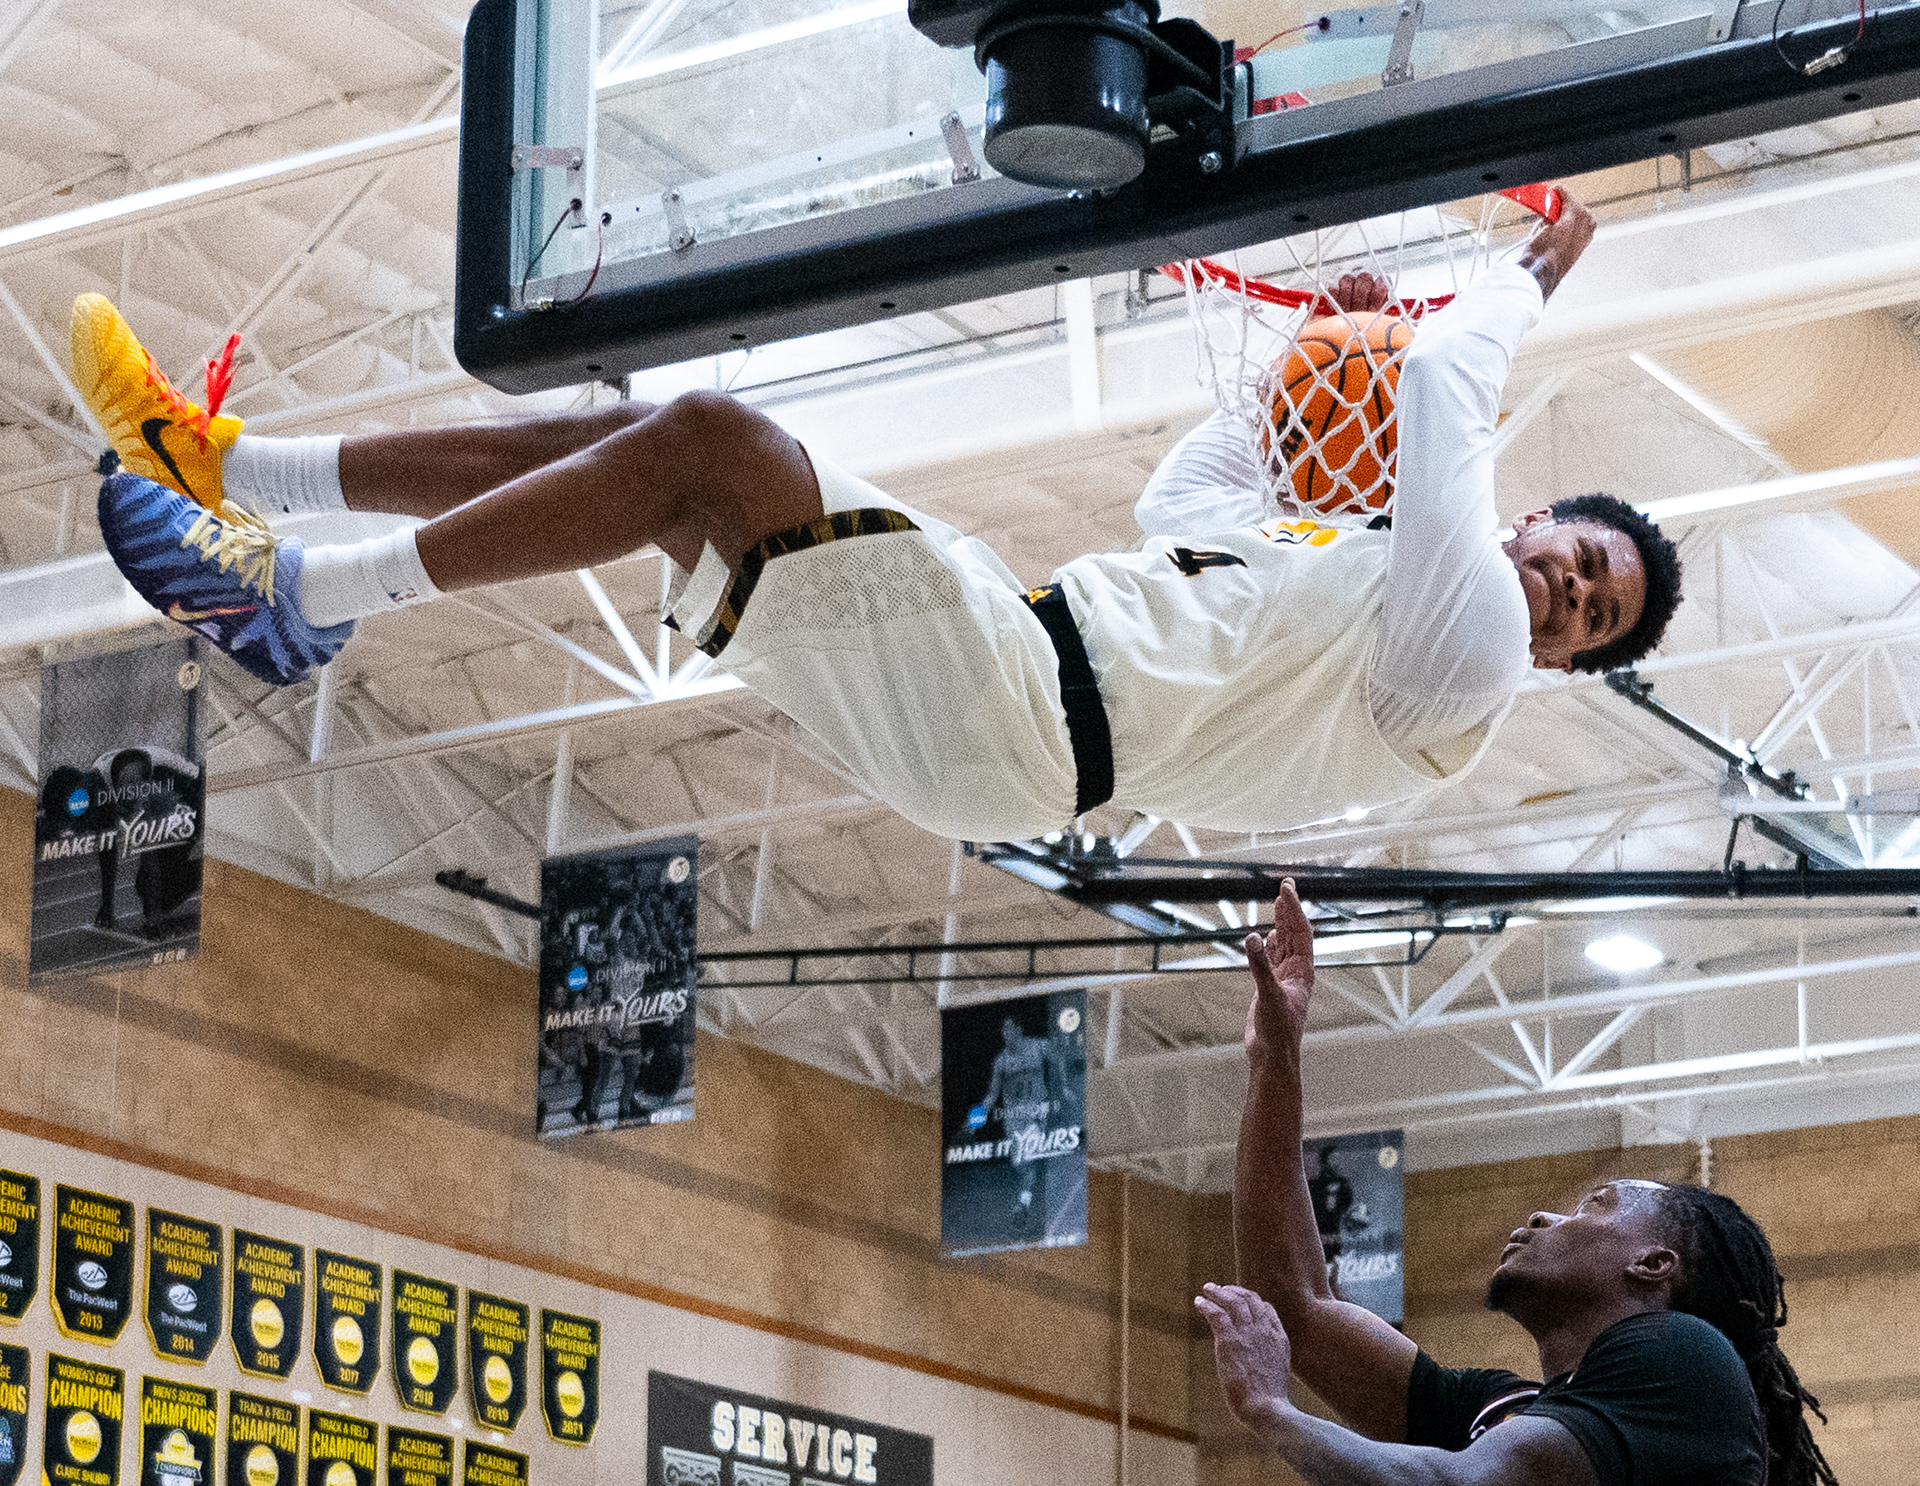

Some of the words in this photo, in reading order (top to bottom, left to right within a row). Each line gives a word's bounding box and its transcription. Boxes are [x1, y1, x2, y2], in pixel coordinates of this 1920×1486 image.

[97, 781, 162, 806] DIVISION
[41, 834, 95, 861] MAKE
[99, 830, 118, 852] IT
[119, 808, 197, 859] YOURS
[545, 1008, 595, 1032] MAKE
[598, 1004, 616, 1023] IT
[617, 986, 689, 1031] YOURS
[947, 1141, 993, 1164] MAKE
[996, 1138, 1013, 1157] IT
[1013, 1123, 1081, 1165] YOURS
[69, 1198, 121, 1224] ACADEMIC
[60, 1212, 130, 1243] ACHIEVEMENT
[160, 1221, 210, 1248] ACADEMIC
[75, 1234, 113, 1257] AWARD
[153, 1237, 219, 1266] ACHIEVEMENT
[245, 1242, 294, 1267] ACADEMIC
[166, 1258, 202, 1280] AWARD
[237, 1256, 302, 1285] ACHIEVEMENT
[326, 1260, 373, 1286] ACADEMIC
[251, 1277, 286, 1299] AWARD
[321, 1274, 381, 1303] ACHIEVEMENT
[403, 1281, 448, 1306] ACADEMIC
[331, 1295, 366, 1316] AWARD
[396, 1296, 456, 1323] ACHIEVEMENT
[477, 1301, 520, 1325] ACADEMIC
[79, 1310, 103, 1330] 2013
[408, 1315, 441, 1337] AWARD
[471, 1316, 527, 1342] ACHIEVEMENT
[551, 1319, 592, 1341] ACADEMIC
[172, 1334, 195, 1352] 2014
[482, 1334, 514, 1355] AWARD
[545, 1333, 598, 1356] ACHIEVEMENT
[257, 1352, 280, 1370] 2015
[557, 1352, 587, 1371] AWARD
[58, 1363, 95, 1383] WOMEN'S
[96, 1372, 116, 1387] GOLF
[50, 1377, 122, 1421] CHAMPION
[152, 1385, 177, 1401] MEN'S
[178, 1391, 207, 1406] SOCCER
[144, 1397, 215, 1437] CHAMPIONS
[239, 1399, 264, 1416] TRACK
[265, 1407, 271, 1417] &
[272, 1406, 292, 1423] FIELD
[232, 1414, 297, 1453] CHAMPION
[319, 1417, 342, 1433] TRACK
[350, 1424, 369, 1440] FIELD
[311, 1431, 375, 1470] CHAMPION
[399, 1437, 444, 1458] ACADEMIC
[711, 1400, 877, 1484] SERVICE
[391, 1451, 452, 1475] ACHIEVEMENT
[475, 1452, 519, 1475] ACADEMIC
[404, 1471, 437, 1486] AWARD
[467, 1466, 526, 1486] ACHIEVEMENT
